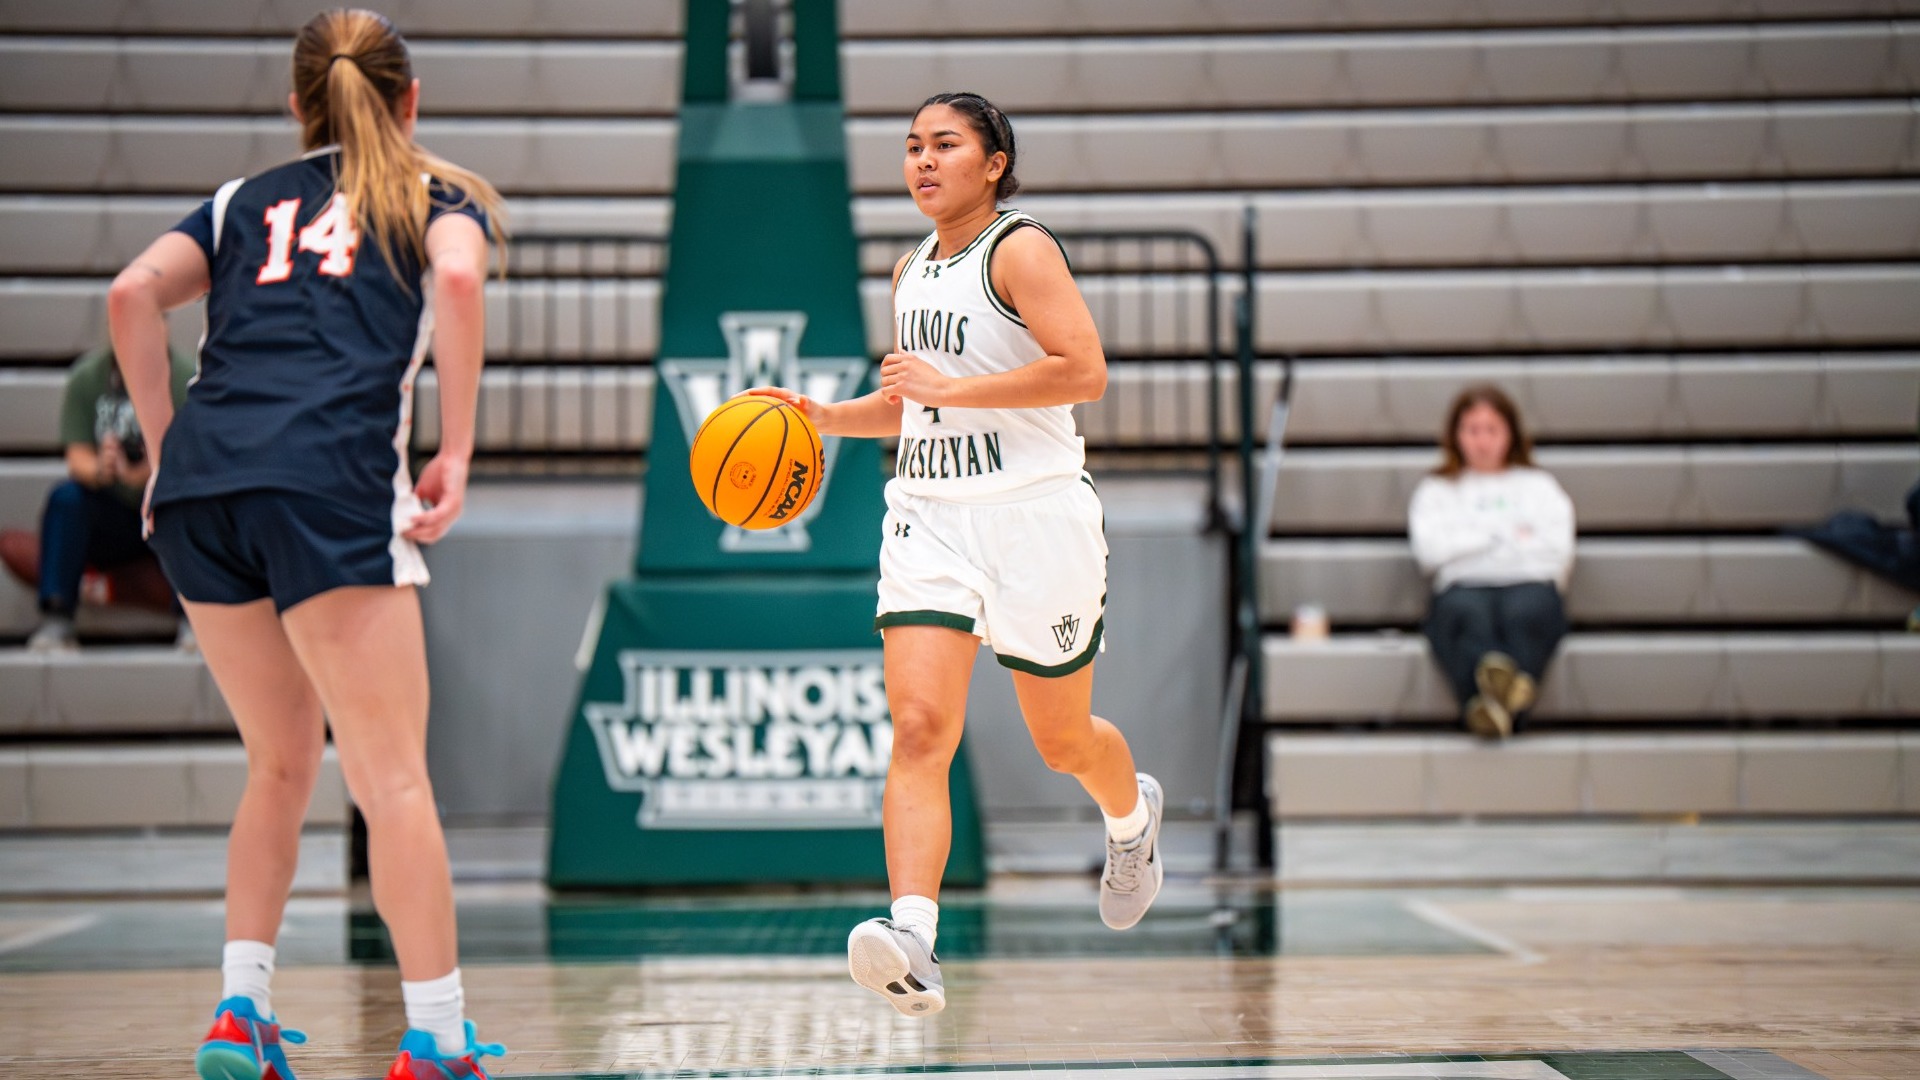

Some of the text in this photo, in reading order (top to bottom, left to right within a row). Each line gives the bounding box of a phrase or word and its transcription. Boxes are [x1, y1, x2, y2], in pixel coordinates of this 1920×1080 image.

[256, 192, 359, 286] 14
[896, 309, 969, 356] LINOIS
[899, 432, 1002, 478] WESLEYAN
[769, 460, 808, 519] NCAA
[640, 667, 889, 722] ILLINOIS
